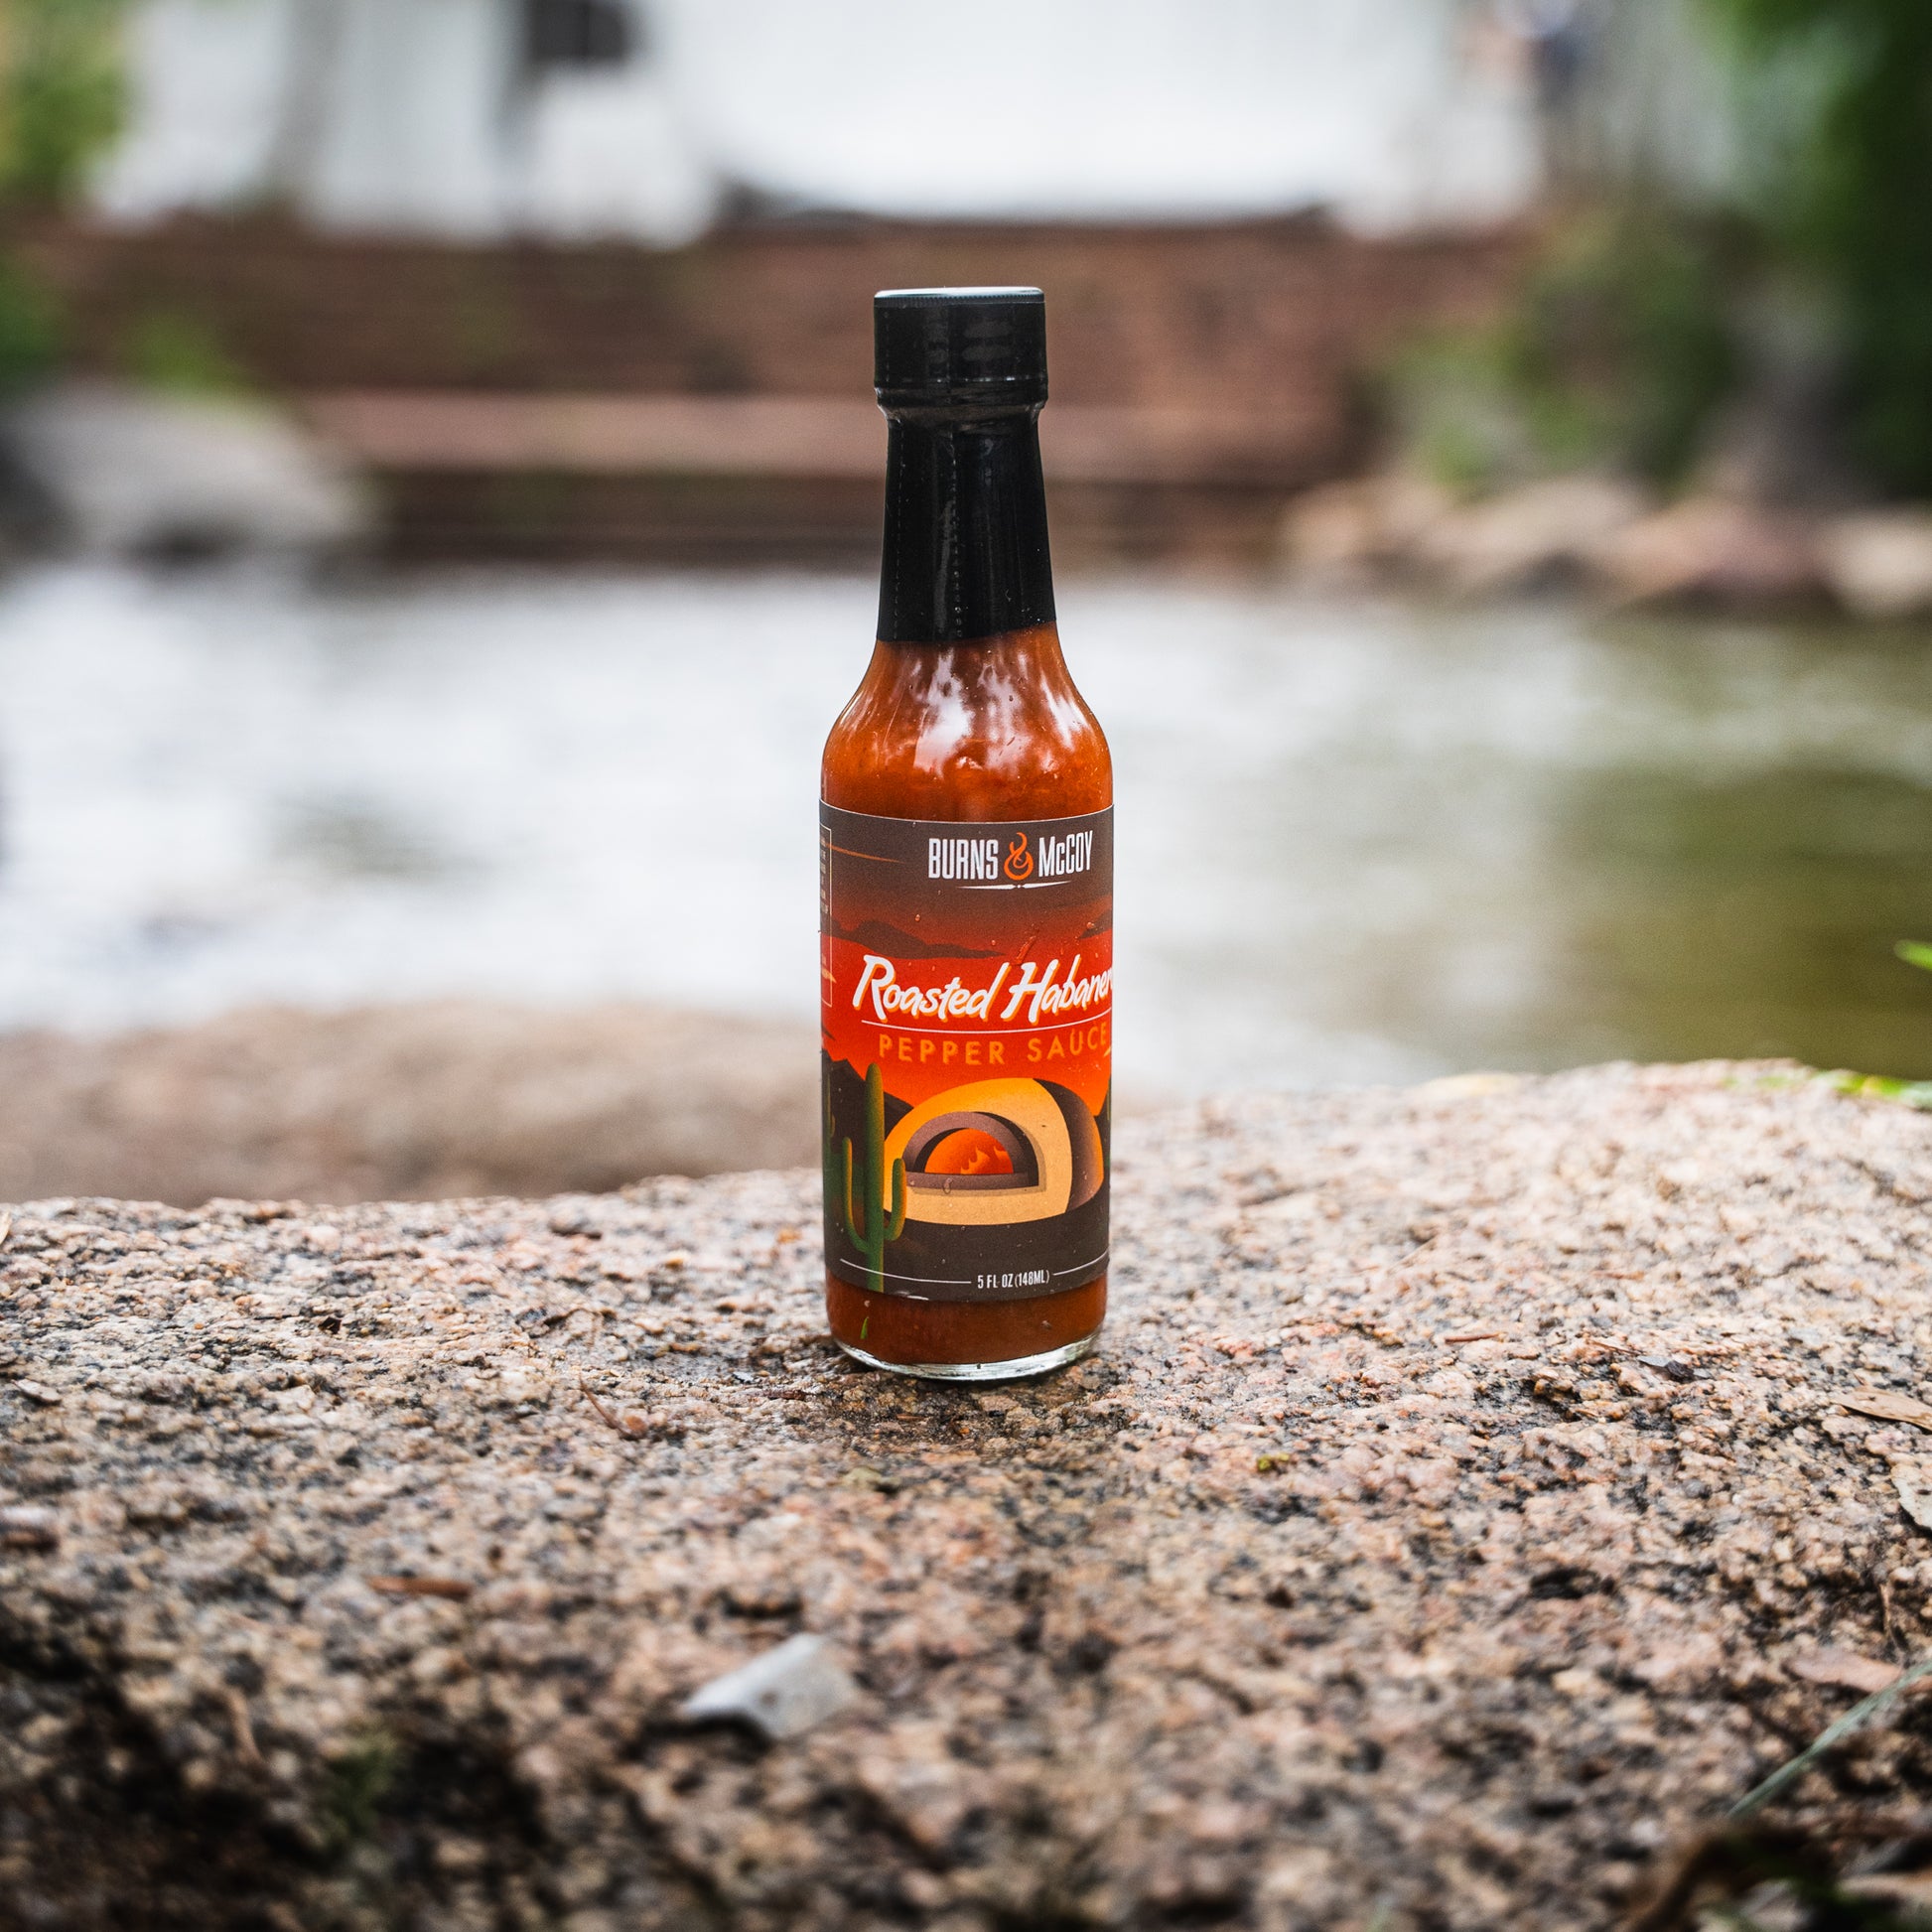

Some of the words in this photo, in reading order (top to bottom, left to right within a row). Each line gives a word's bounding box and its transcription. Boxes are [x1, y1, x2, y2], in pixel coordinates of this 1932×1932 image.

[927, 837, 999, 880] BURNS
[852, 954, 1011, 1022] Roasted
[1000, 953, 1112, 1024] Habaner
[879, 1034, 1005, 1065] PEPPER
[1027, 1022, 1108, 1060] SAUCE
[977, 1274, 984, 1289] 5
[986, 1274, 999, 1289] FL
